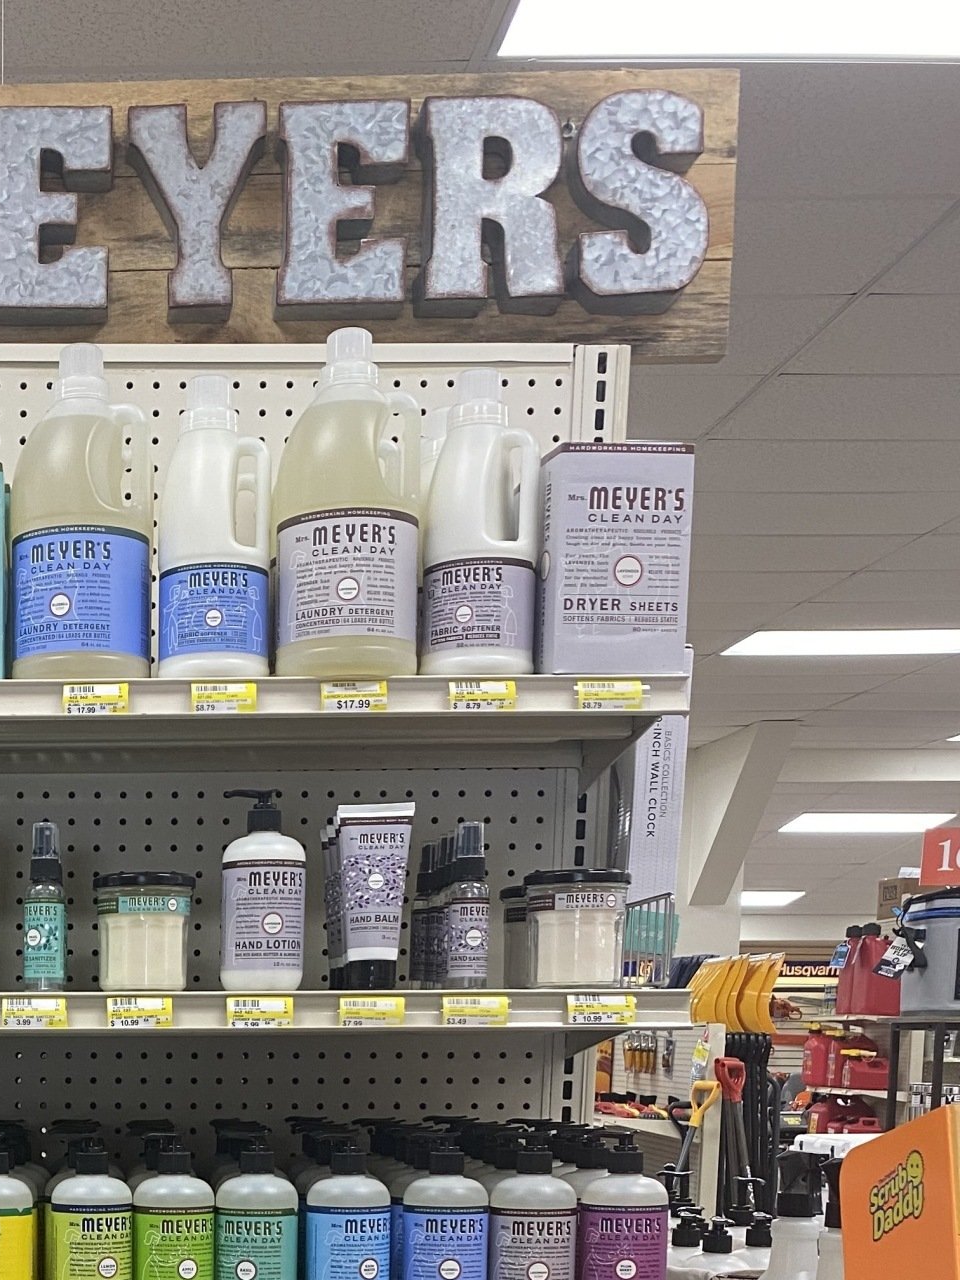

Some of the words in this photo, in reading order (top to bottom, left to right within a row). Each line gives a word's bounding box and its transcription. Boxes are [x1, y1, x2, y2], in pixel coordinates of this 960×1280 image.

[589, 486, 686, 511] MEYER'S
[589, 514, 644, 523] CLEAN
[651, 514, 683, 524] DAY
[313, 523, 396, 546] MEYER'S
[31, 540, 112, 562] MEYER'S
[442, 568, 503, 585] MEYER'S
[564, 598, 621, 611] DRYER
[630, 602, 678, 612] SHEETS
[296, 607, 344, 619] LAUNDRY
[349, 608, 394, 618] DETERGENT
[336, 699, 370, 709] $17.99
[662, 730, 672, 761] BASICS
[649, 761, 660, 793] WALL
[659, 763, 670, 818] COLLECTION
[646, 798, 658, 838] CLOCK
[359, 833, 405, 844] MEYER'S
[248, 872, 303, 887] MEYER'S
[350, 914, 371, 924] HAND
[374, 915, 399, 924] BALM
[235, 941, 263, 950] HAND
[267, 940, 300, 950] LOTION
[779, 962, 840, 977] Husqvarn
[870, 1163, 908, 1214] Scrub
[873, 1182, 924, 1241] Daddy
[224, 1220, 282, 1235] MEYER'S
[425, 1218, 483, 1233] MEYER'S
[512, 1219, 571, 1235] MEYER'S
